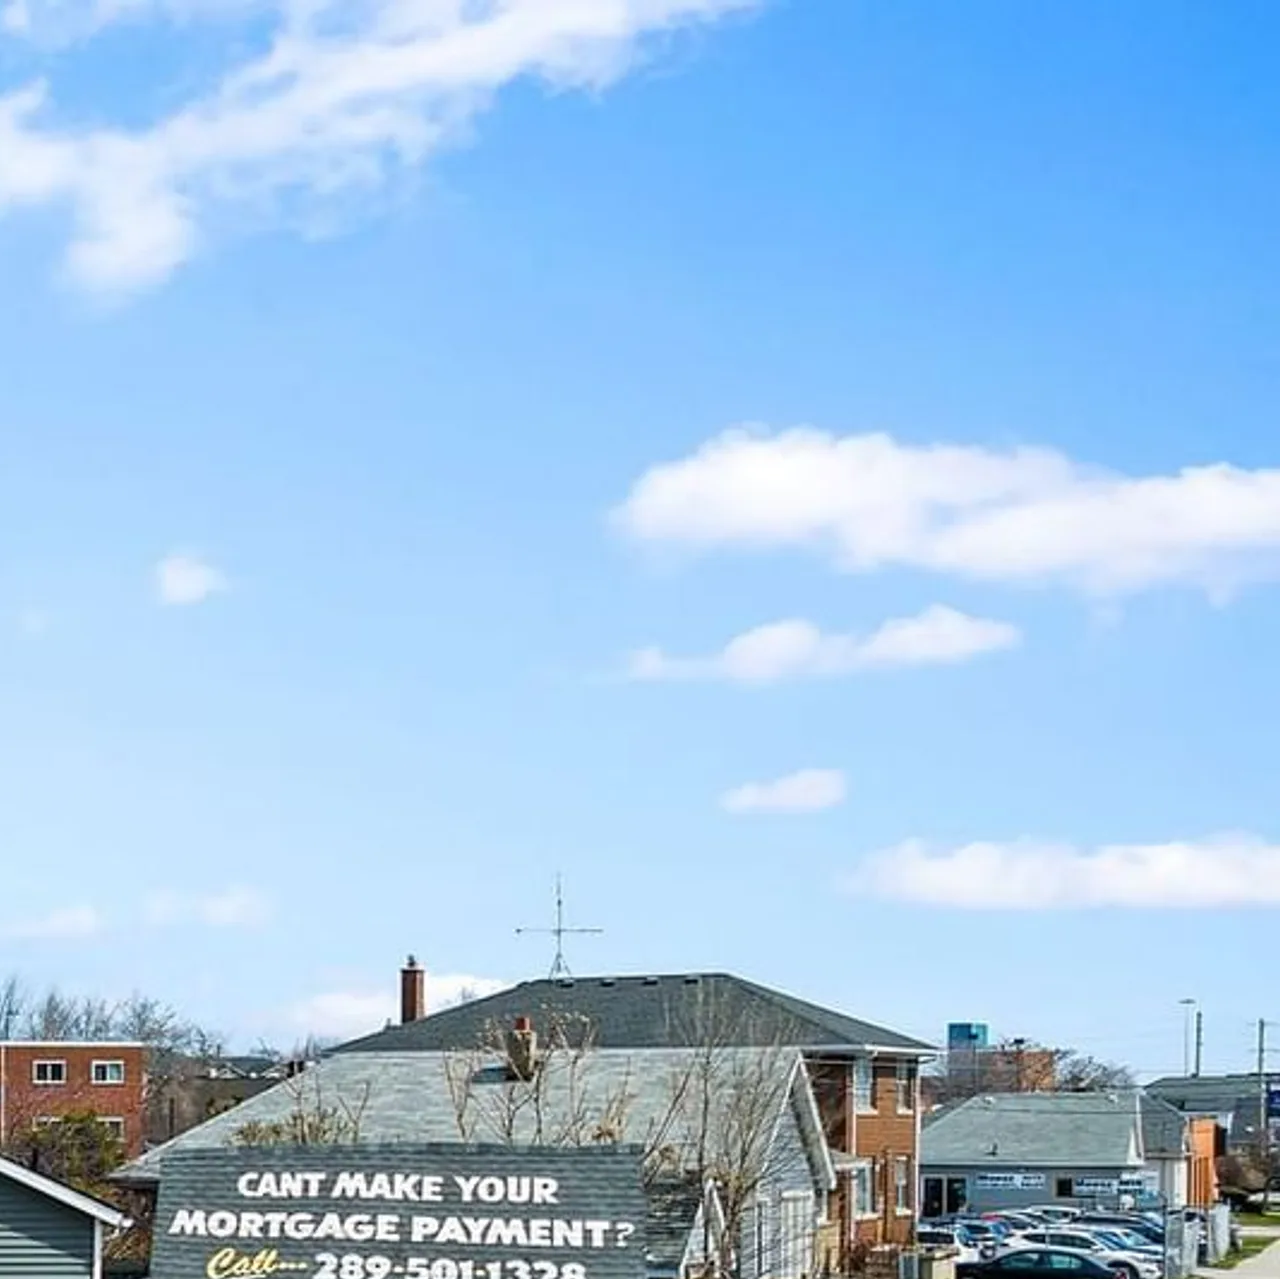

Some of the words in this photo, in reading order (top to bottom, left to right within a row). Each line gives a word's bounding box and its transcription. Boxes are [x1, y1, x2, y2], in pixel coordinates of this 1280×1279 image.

[237, 1170, 326, 1198] CANT
[331, 1172, 445, 1200] MAKE
[454, 1176, 560, 1204] YOUR
[168, 1209, 400, 1242] MORTGAGE
